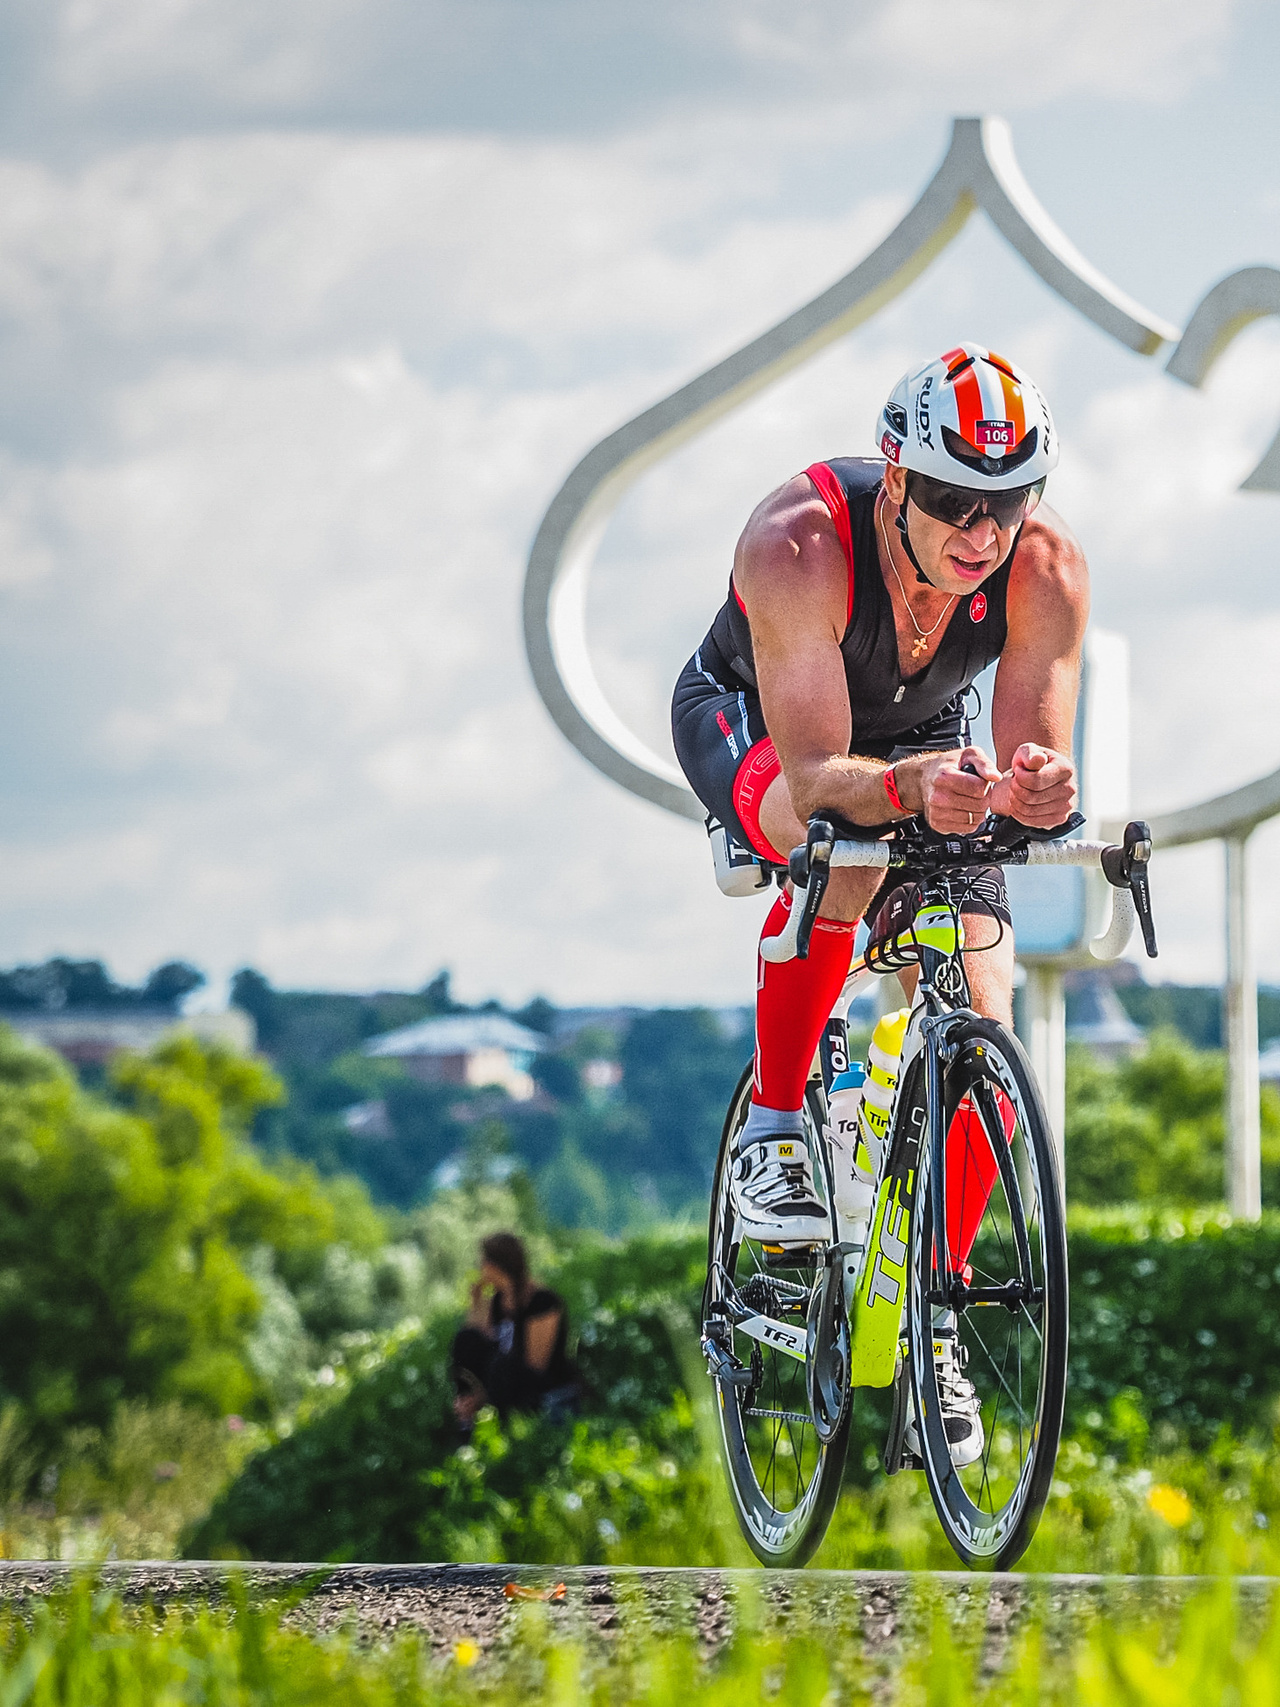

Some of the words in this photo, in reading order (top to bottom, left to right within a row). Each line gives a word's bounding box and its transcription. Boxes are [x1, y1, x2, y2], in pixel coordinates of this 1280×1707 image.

[918, 376, 936, 452] RUDY
[985, 430, 1009, 443] 106
[883, 441, 897, 460] 106
[837, 1119, 858, 1134] Ta
[763, 1324, 798, 1349] TF2
